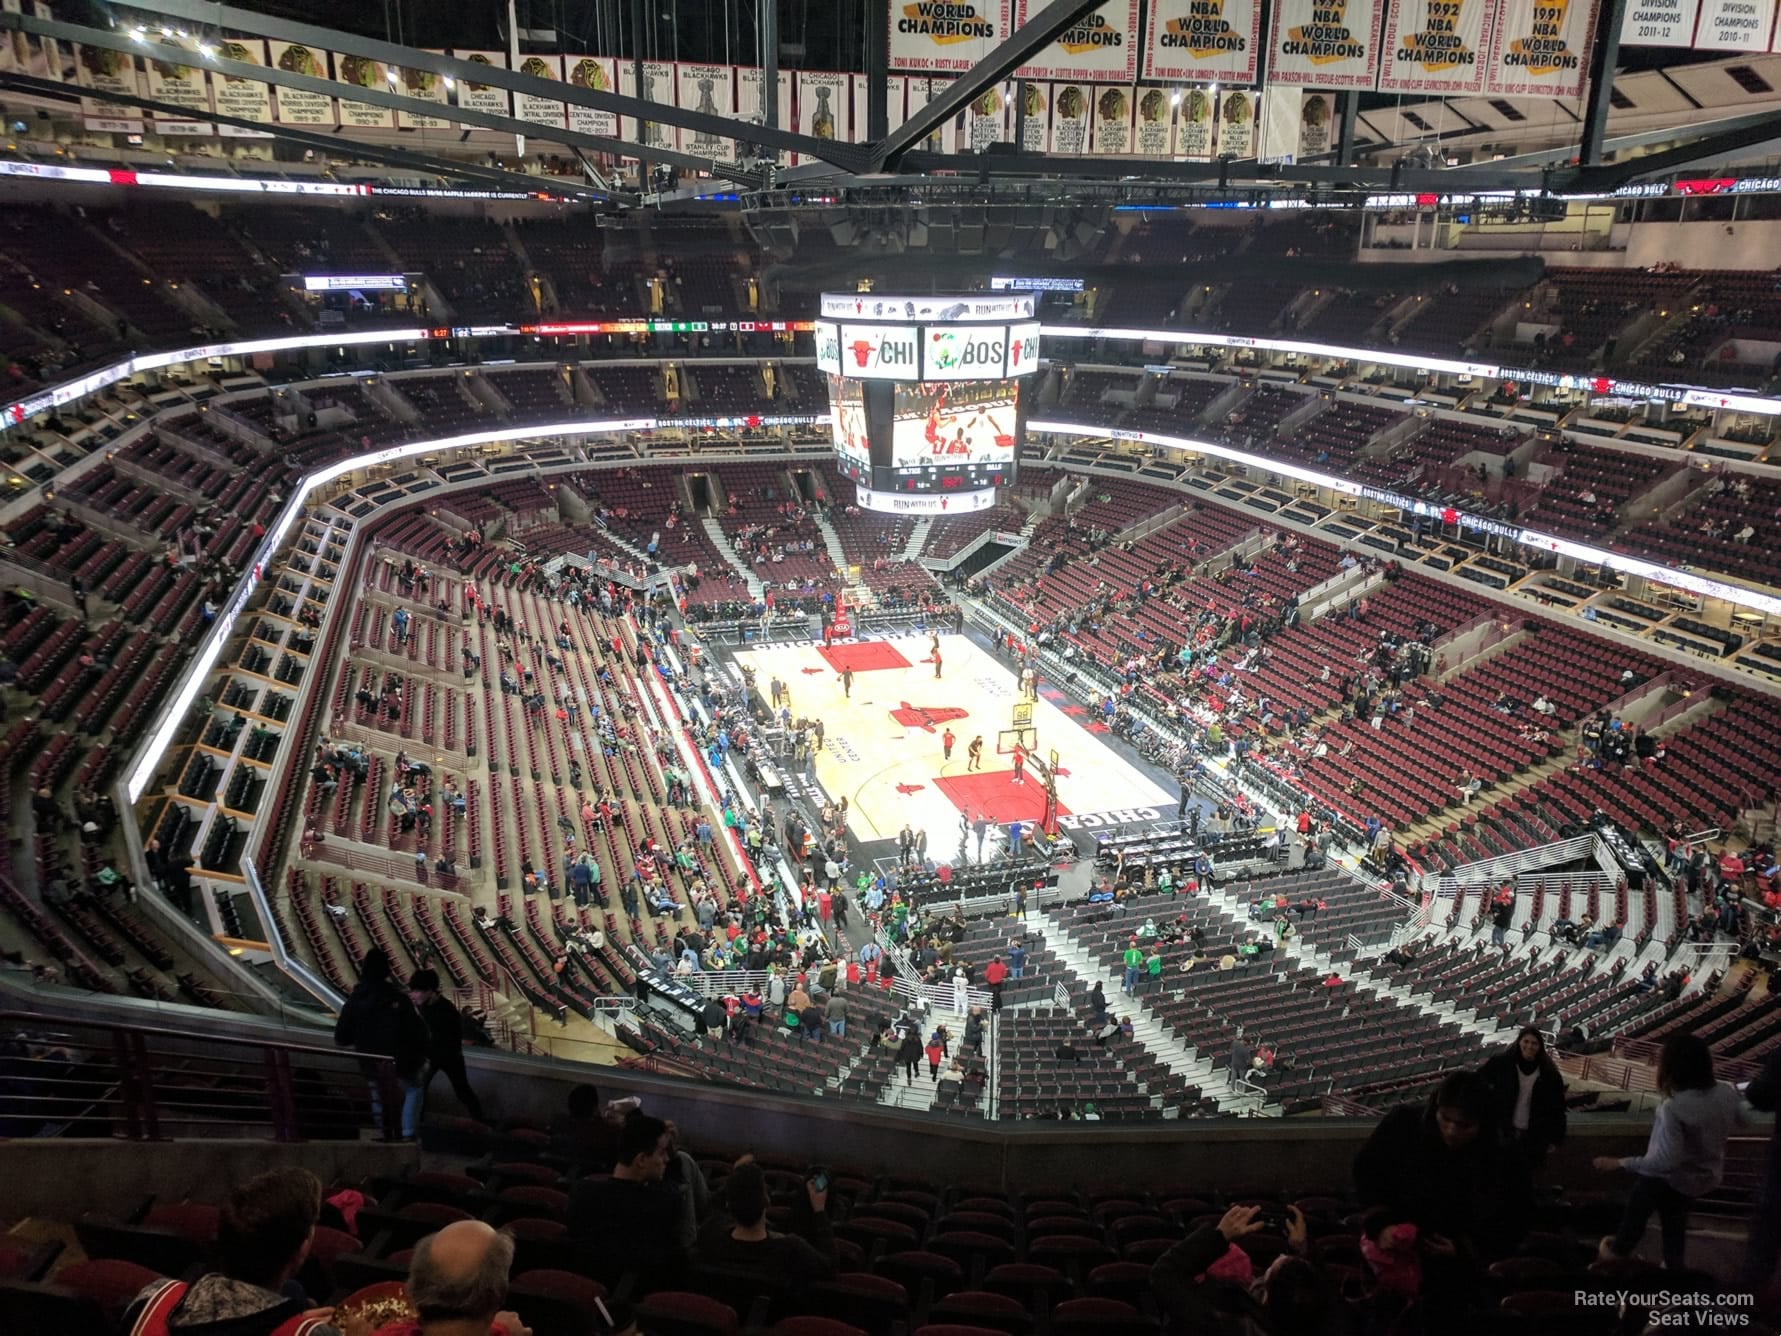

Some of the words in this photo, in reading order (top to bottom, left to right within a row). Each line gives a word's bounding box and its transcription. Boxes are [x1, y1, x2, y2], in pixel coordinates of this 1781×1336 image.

[918, 3, 976, 19] WORLD
[1190, 2, 1219, 16] NBA
[1427, 2, 1460, 16] 1992
[1533, 8, 1562, 21] 1991
[1722, 3, 1756, 14] DIVISION
[1312, 10, 1341, 23] NBA
[1633, 11, 1681, 23] CHAMPIONS
[1714, 17, 1759, 29] CHAMPIONS
[898, 19, 994, 38] CHAMPIONS
[1178, 18, 1230, 33] WORLD
[1427, 18, 1453, 32] NBA
[1532, 23, 1558, 36] NBA
[1056, 30, 1123, 47] MPIONS
[1301, 25, 1350, 40] WORLD
[1386, 22, 1398, 57] PERDUE
[1160, 34, 1246, 51] CHAMPIONS
[1415, 33, 1462, 48] WORLD
[1522, 38, 1567, 52] WORLD
[1282, 41, 1365, 58] CHAMPIONS
[1397, 48, 1475, 65] CHAMPIONS
[894, 57, 907, 68] TONI
[909, 57, 929, 69] KUKOC
[935, 59, 951, 70] RUSTY
[953, 60, 970, 70] LARUE
[1475, 49, 1487, 82] JORDAN
[1504, 54, 1577, 69] CHAMPIONS
[623, 69, 669, 77] BLAHAWKS
[683, 72, 728, 80] BLACKHAWKS
[1382, 59, 1393, 79] WILL
[801, 78, 844, 86] BLACKHAWKS
[1381, 79, 1398, 89] STACEY
[288, 107, 324, 115] CHAMPIONS
[349, 111, 384, 119] CHAMPIONS
[1738, 177, 1779, 190] CHICAGO
[383, 188, 409, 196] CHICAGO
[881, 341, 913, 365] CHI
[963, 341, 1004, 365] BOS
[1024, 336, 1039, 360] CHI
[1500, 368, 1525, 381] BOSTON
[1527, 372, 1553, 384] CELTICS
[1615, 384, 1650, 396] CHICAGO
[1653, 389, 1681, 400] BULLS
[658, 419, 683, 428] BOSTON
[684, 418, 712, 427] CELTICS
[764, 417, 792, 426] CHICAGO
[794, 416, 815, 425] BULLS
[894, 500, 910, 508] RUN
[1363, 487, 1385, 500] BOSTON
[1385, 491, 1409, 508] CELTICS
[1460, 515, 1493, 531] CHICAGO
[1494, 522, 1519, 539] BULLS
